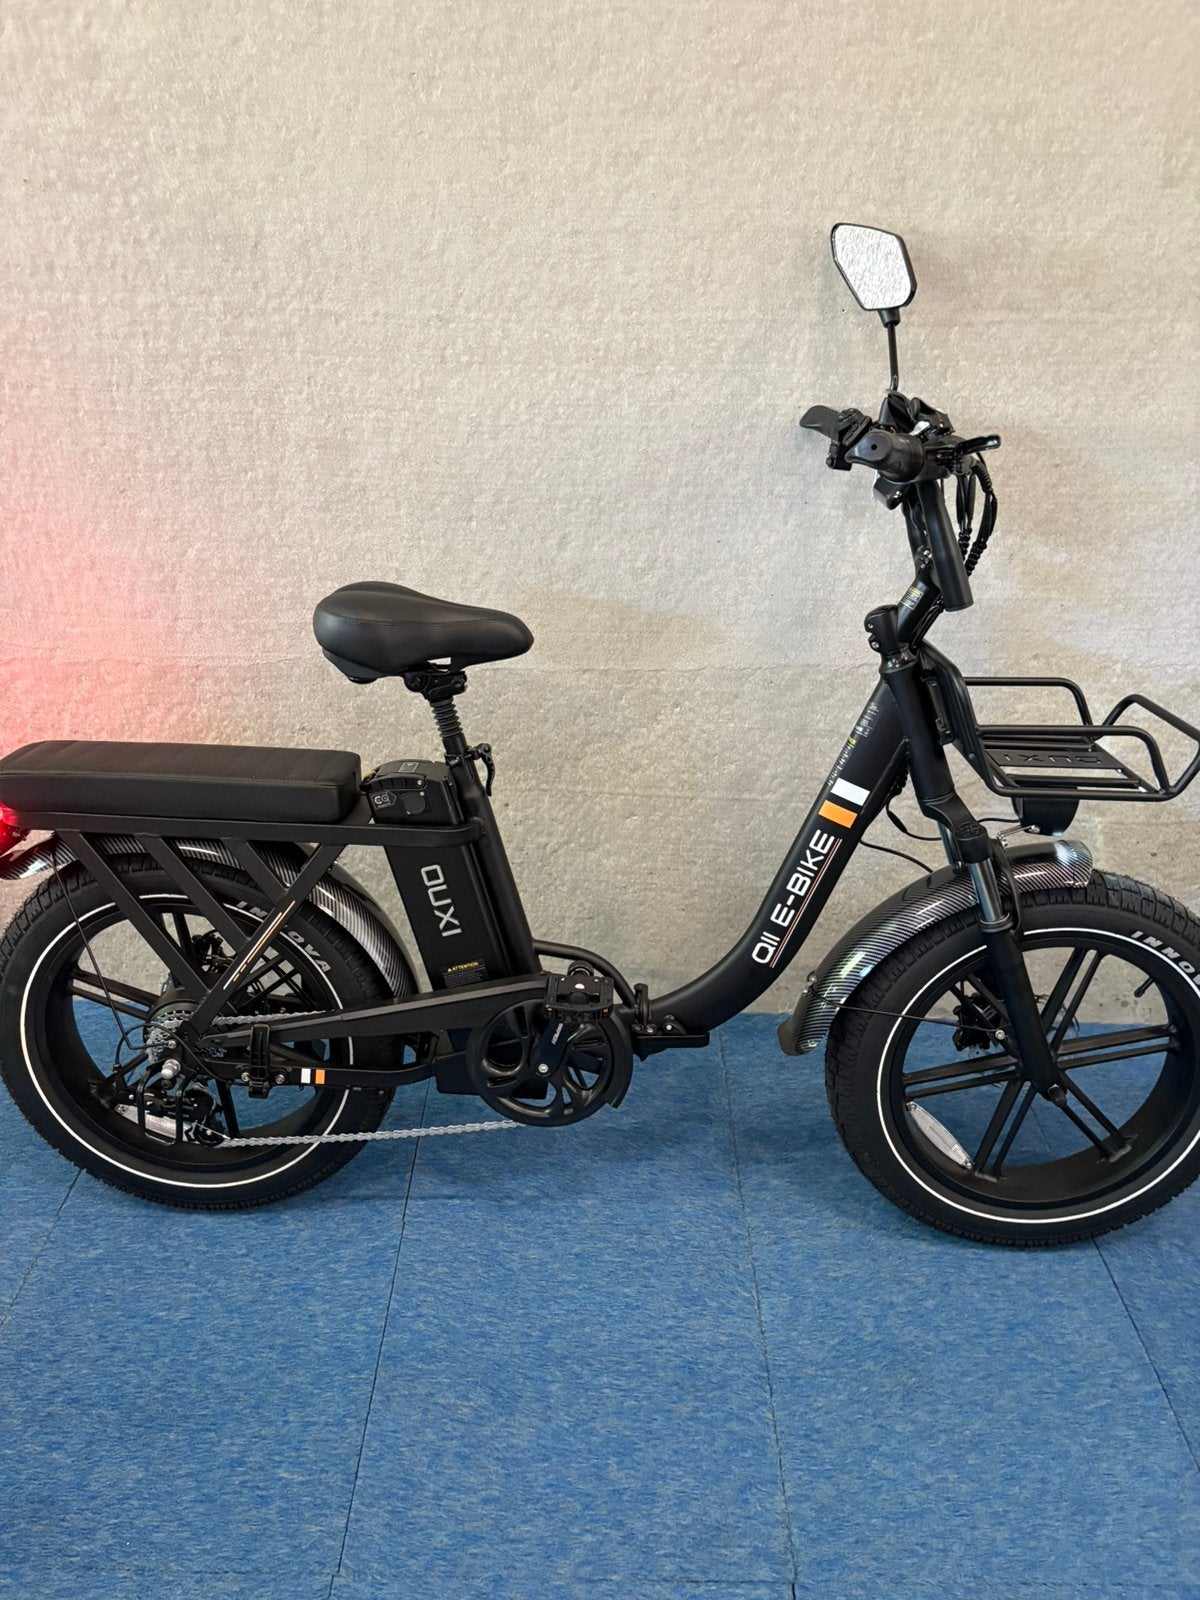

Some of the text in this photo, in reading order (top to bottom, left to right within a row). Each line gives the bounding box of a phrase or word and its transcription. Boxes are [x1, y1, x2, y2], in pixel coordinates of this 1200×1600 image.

[420, 864, 462, 937] OUXI
[769, 829, 835, 927] E-BIKE
[236, 900, 332, 973] INOVA
[452, 961, 479, 972] ATTENTION
